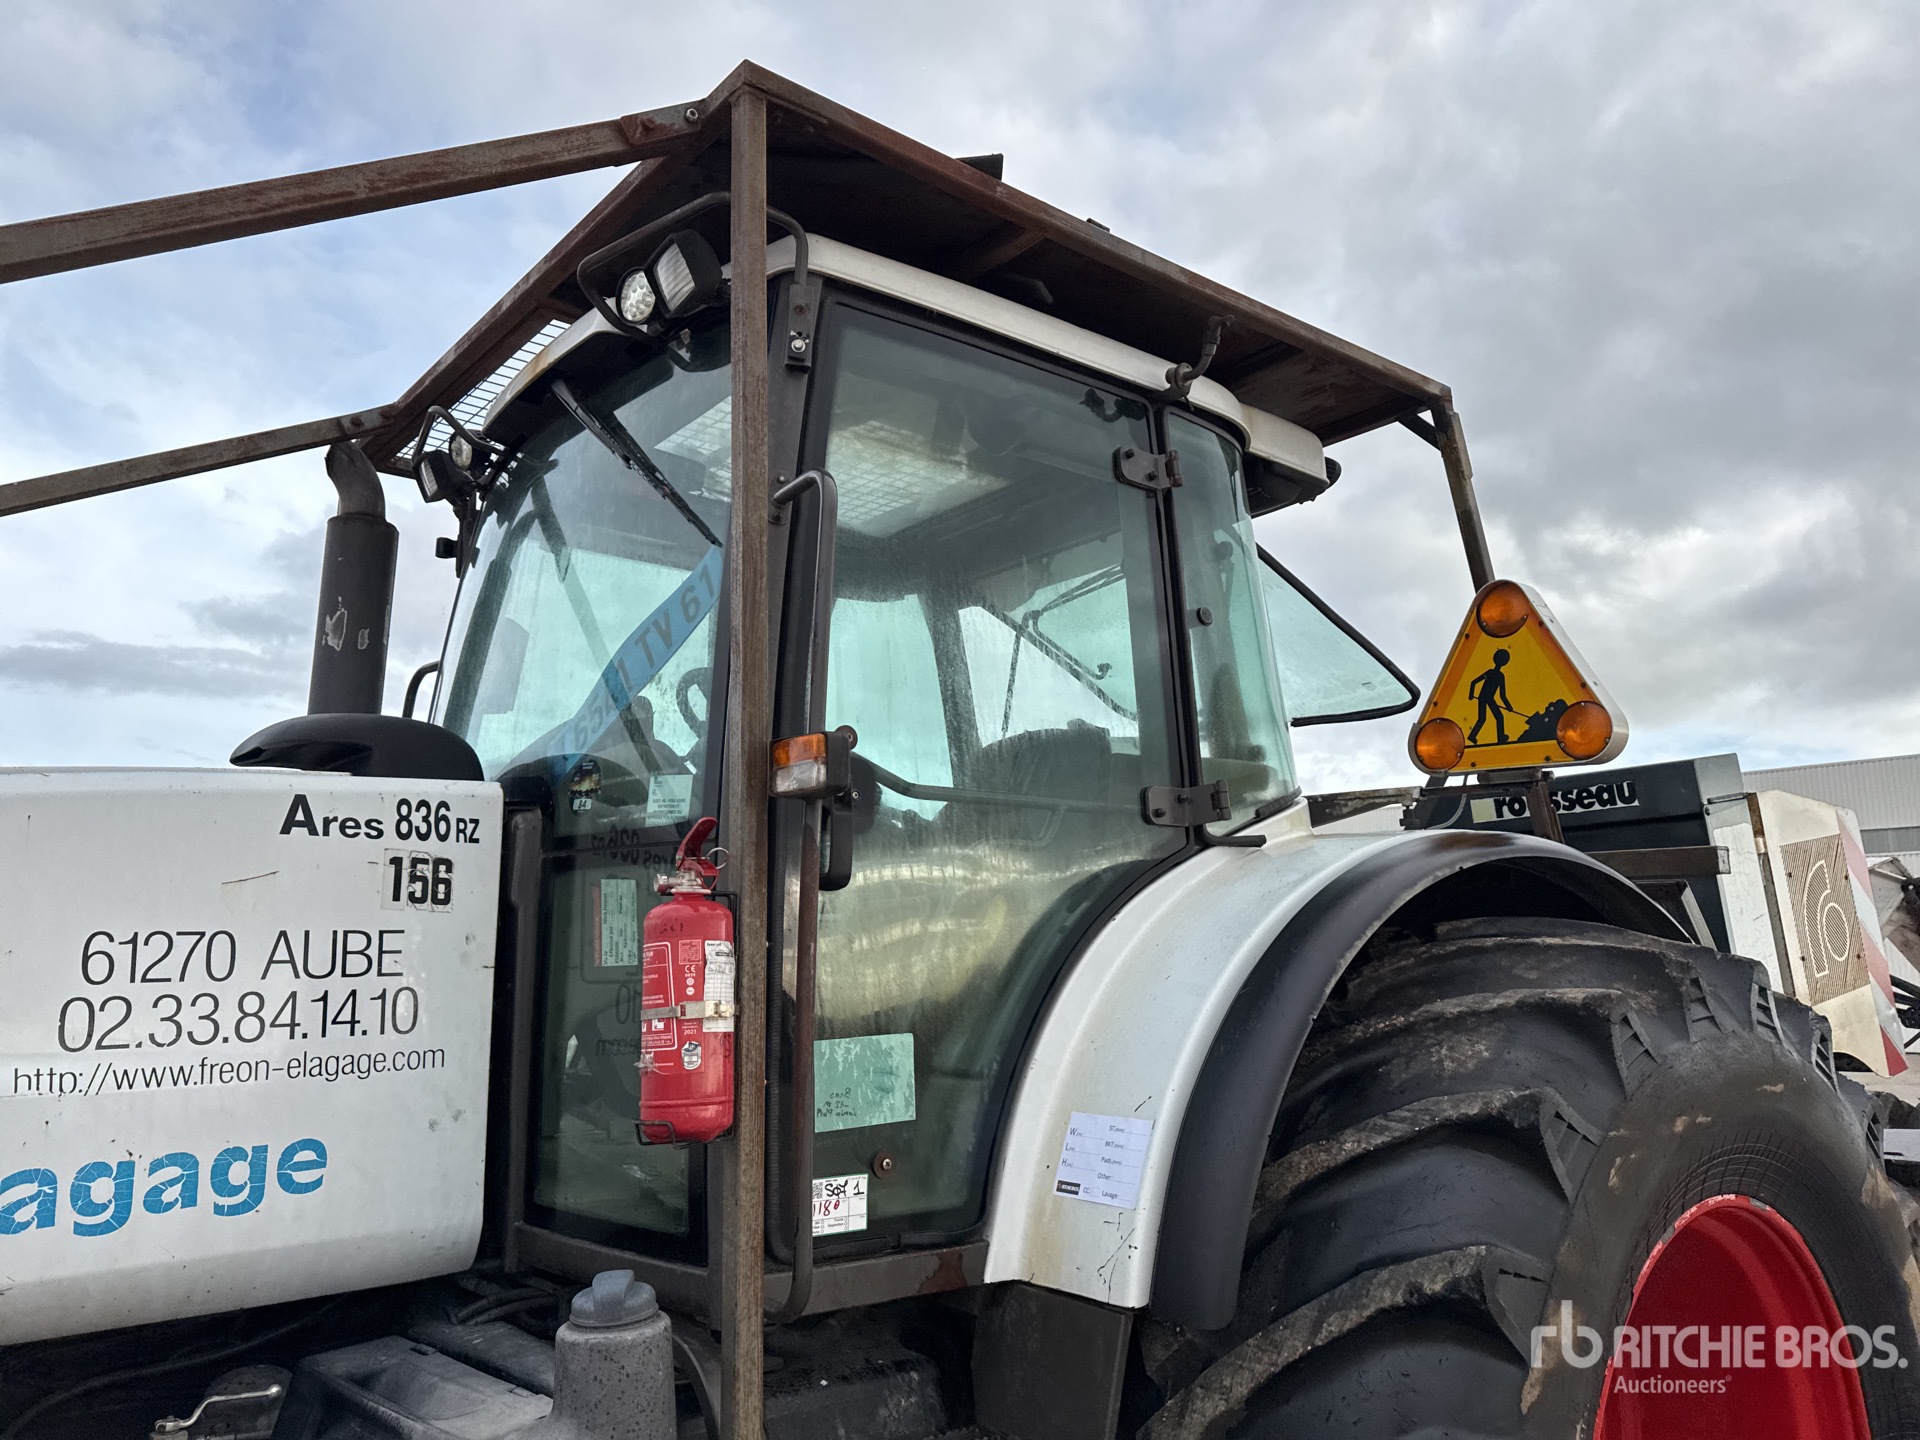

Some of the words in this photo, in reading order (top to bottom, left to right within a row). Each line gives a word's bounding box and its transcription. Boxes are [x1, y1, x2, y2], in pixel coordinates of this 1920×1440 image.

[633, 609, 673, 669] TV
[680, 564, 715, 624] 61
[279, 794, 384, 839] Ares
[1494, 781, 1637, 819] rosseau
[388, 856, 453, 906] 156
[81, 930, 236, 986] 61270
[260, 929, 405, 980] AUBE
[57, 986, 419, 1053] 02.33.84.14.10
[13, 1048, 446, 1096] http://www.freon-elagage.com
